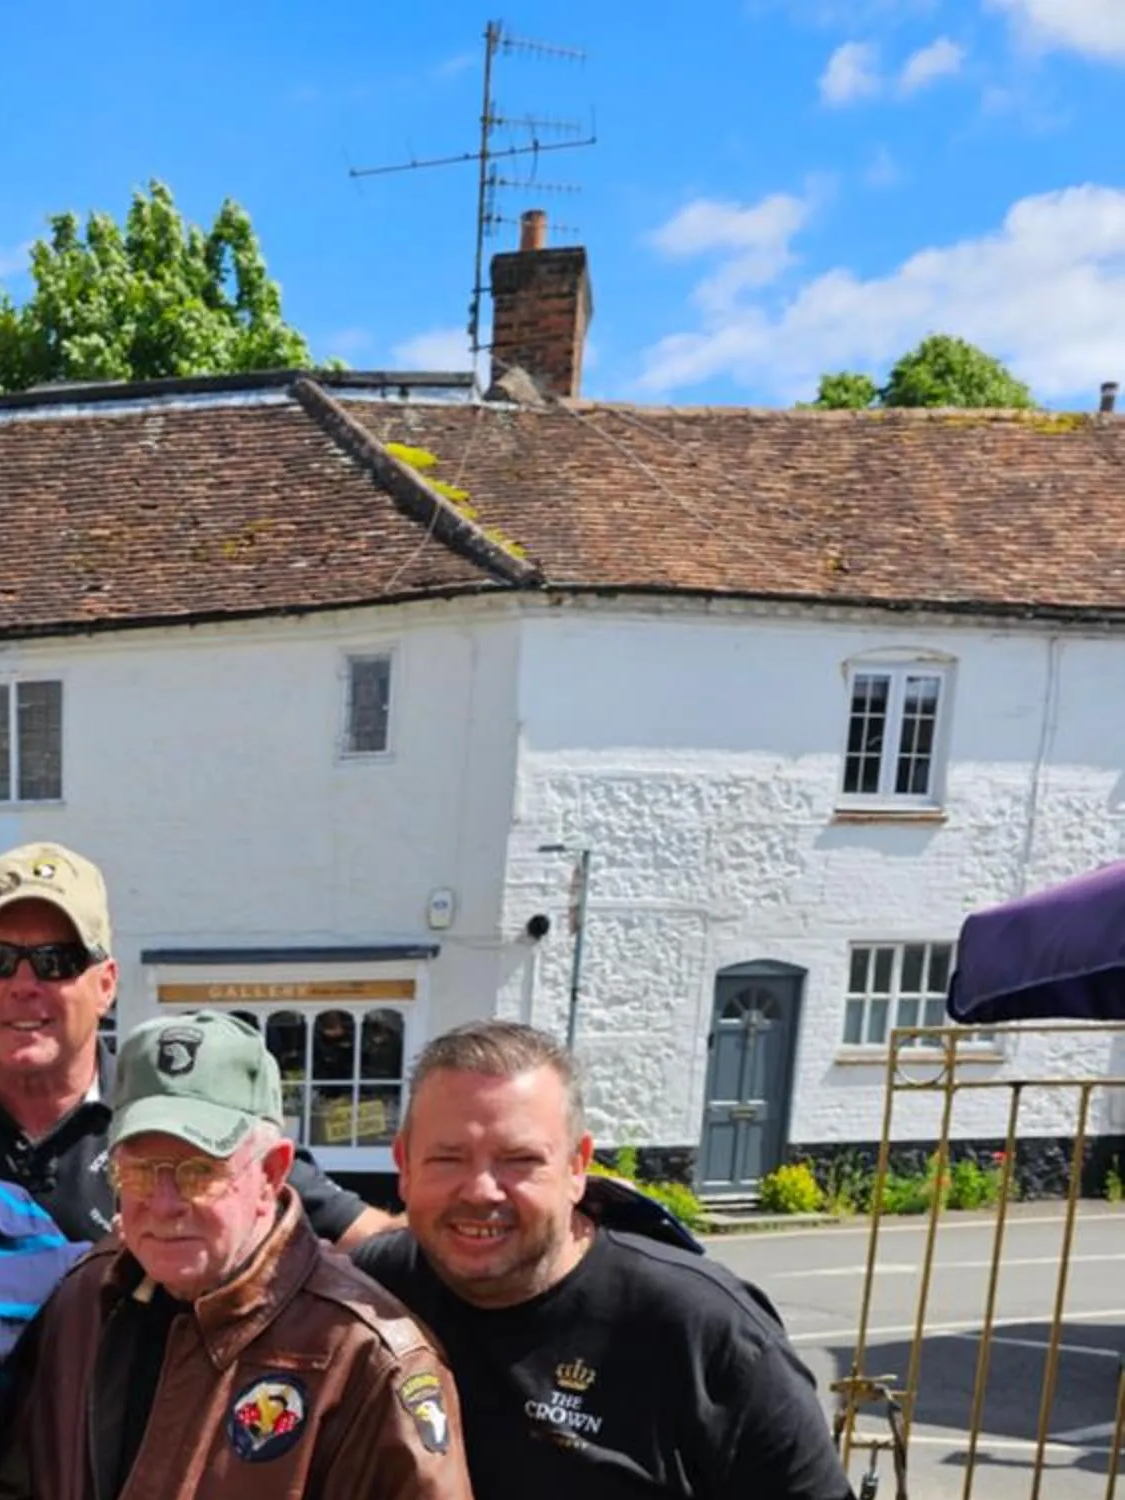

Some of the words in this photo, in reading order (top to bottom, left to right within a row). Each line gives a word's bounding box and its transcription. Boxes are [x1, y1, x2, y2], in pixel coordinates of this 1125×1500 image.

[207, 983, 310, 1000] GALLERY
[551, 1391, 583, 1409] THE
[525, 1400, 603, 1434] CROWN
